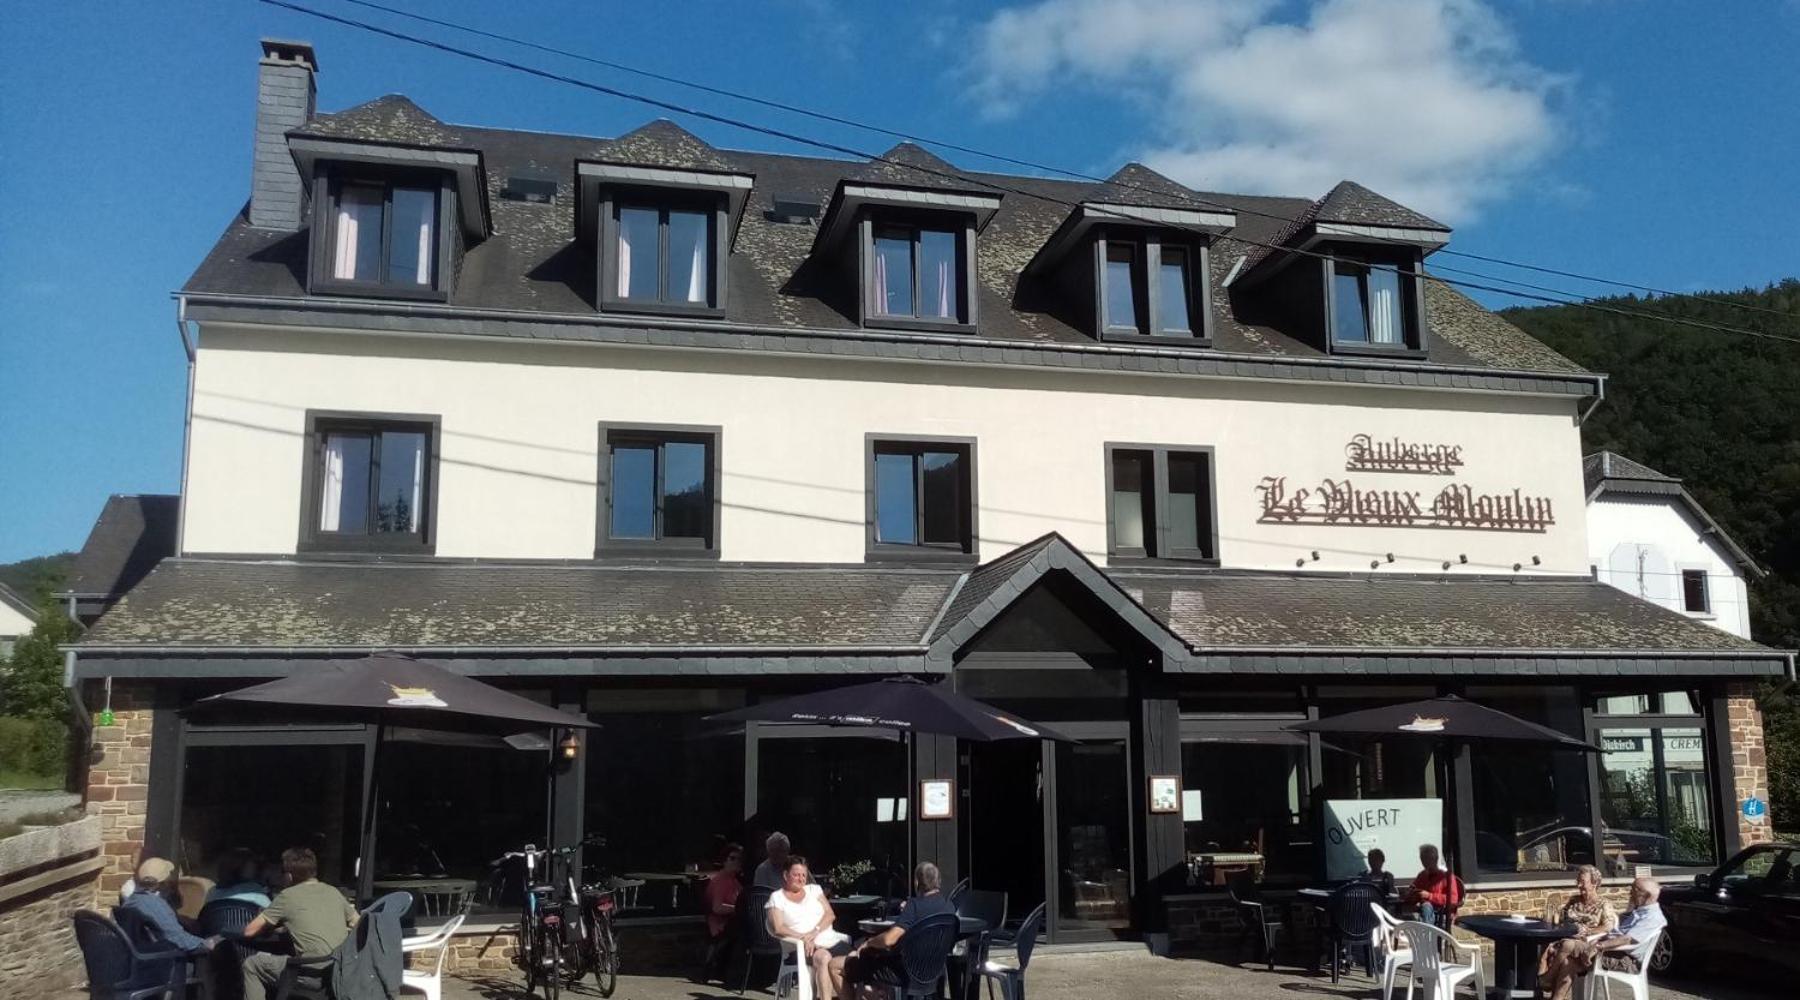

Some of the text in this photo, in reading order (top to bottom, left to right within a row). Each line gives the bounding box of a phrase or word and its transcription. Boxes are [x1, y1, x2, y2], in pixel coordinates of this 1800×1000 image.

[1346, 433, 1463, 474] Auberge
[1256, 477, 1554, 532] Le Vieux Moulin
[1328, 808, 1401, 845] OUVERT
